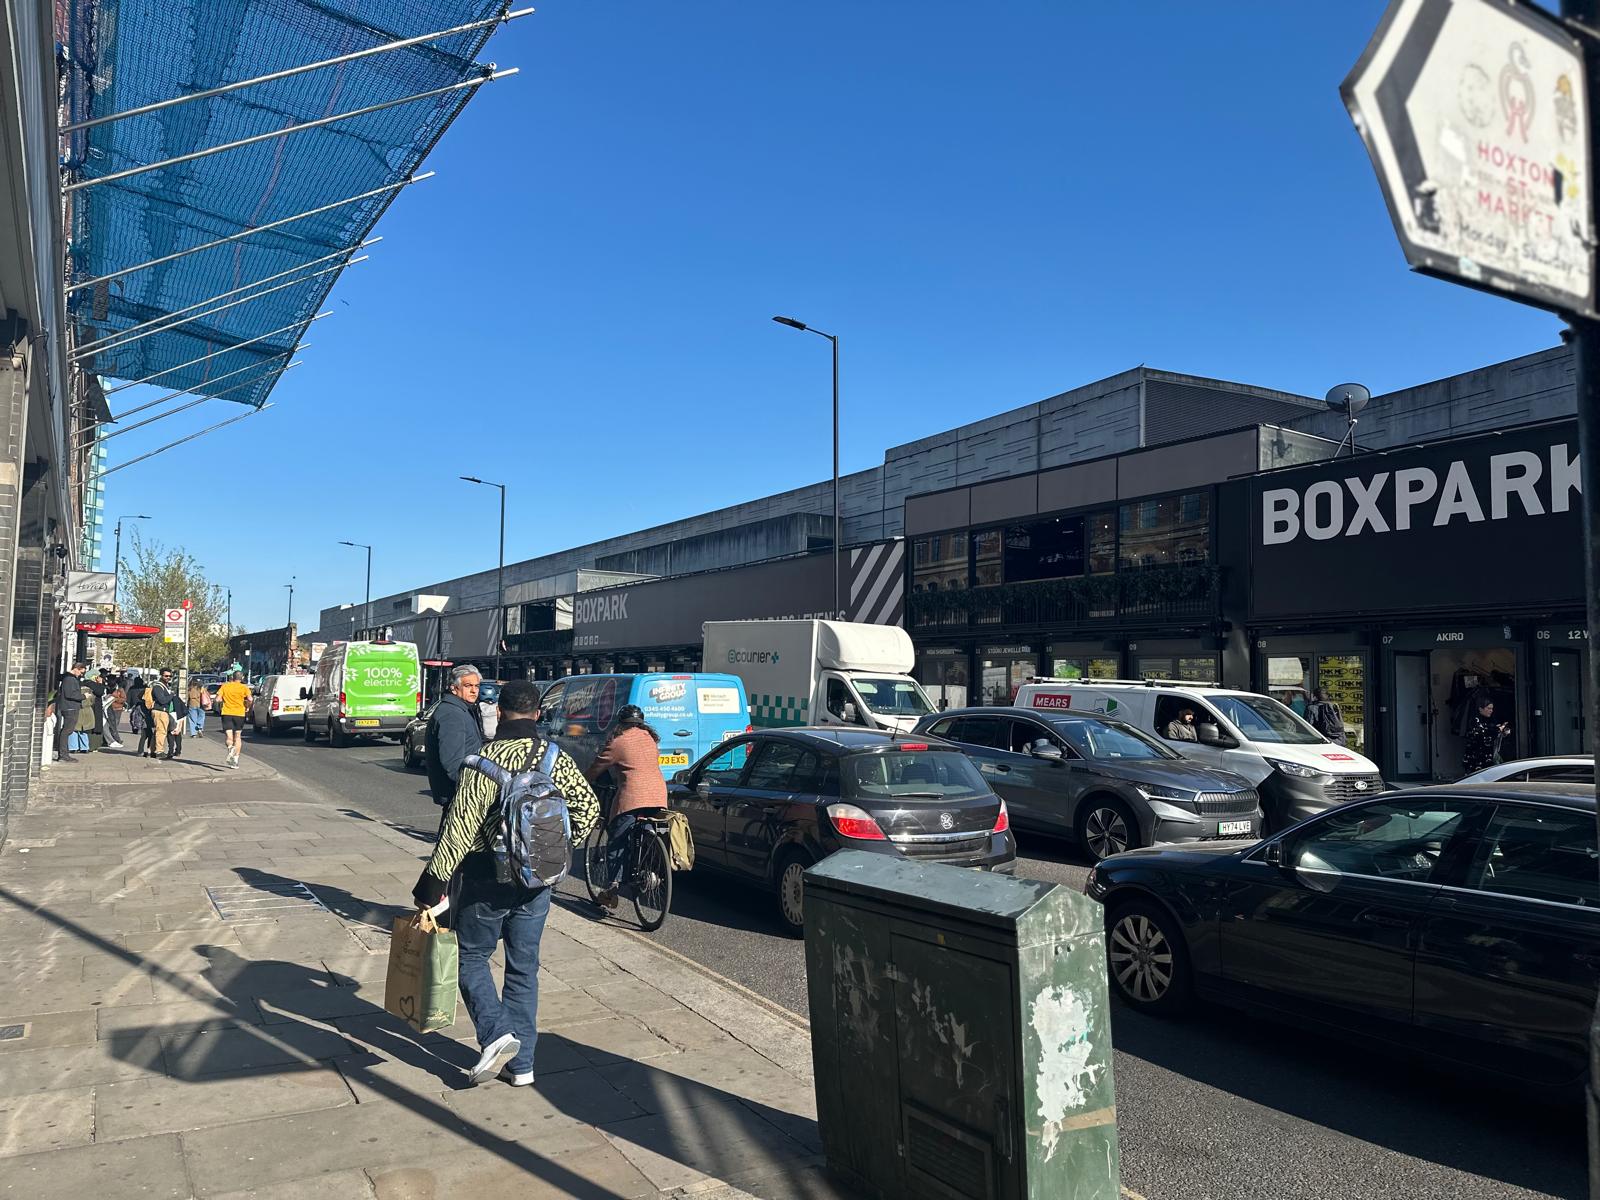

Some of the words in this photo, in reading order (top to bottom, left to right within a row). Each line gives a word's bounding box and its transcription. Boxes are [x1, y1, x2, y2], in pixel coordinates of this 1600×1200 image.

[1477, 140, 1555, 187] HOXTON
[1506, 176, 1528, 198] ST
[1262, 443, 1584, 546] BOXPARK
[576, 593, 628, 623] BOXPARK
[1382, 635, 1393, 644] 07
[1436, 632, 1464, 642] AKIRO
[1536, 630, 1550, 639] 06
[1568, 630, 1581, 639] 12
[1129, 643, 1137, 651] 09
[1257, 640, 1267, 648] 08
[364, 667, 403, 679] 100%
[363, 677, 403, 687] electric
[660, 689, 687, 701] GROUP
[1036, 697, 1069, 709] MEARS
[660, 756, 670, 764] 73
[672, 756, 686, 764] EXS
[1222, 822, 1239, 831] HY74
[1239, 821, 1250, 830] LVE
